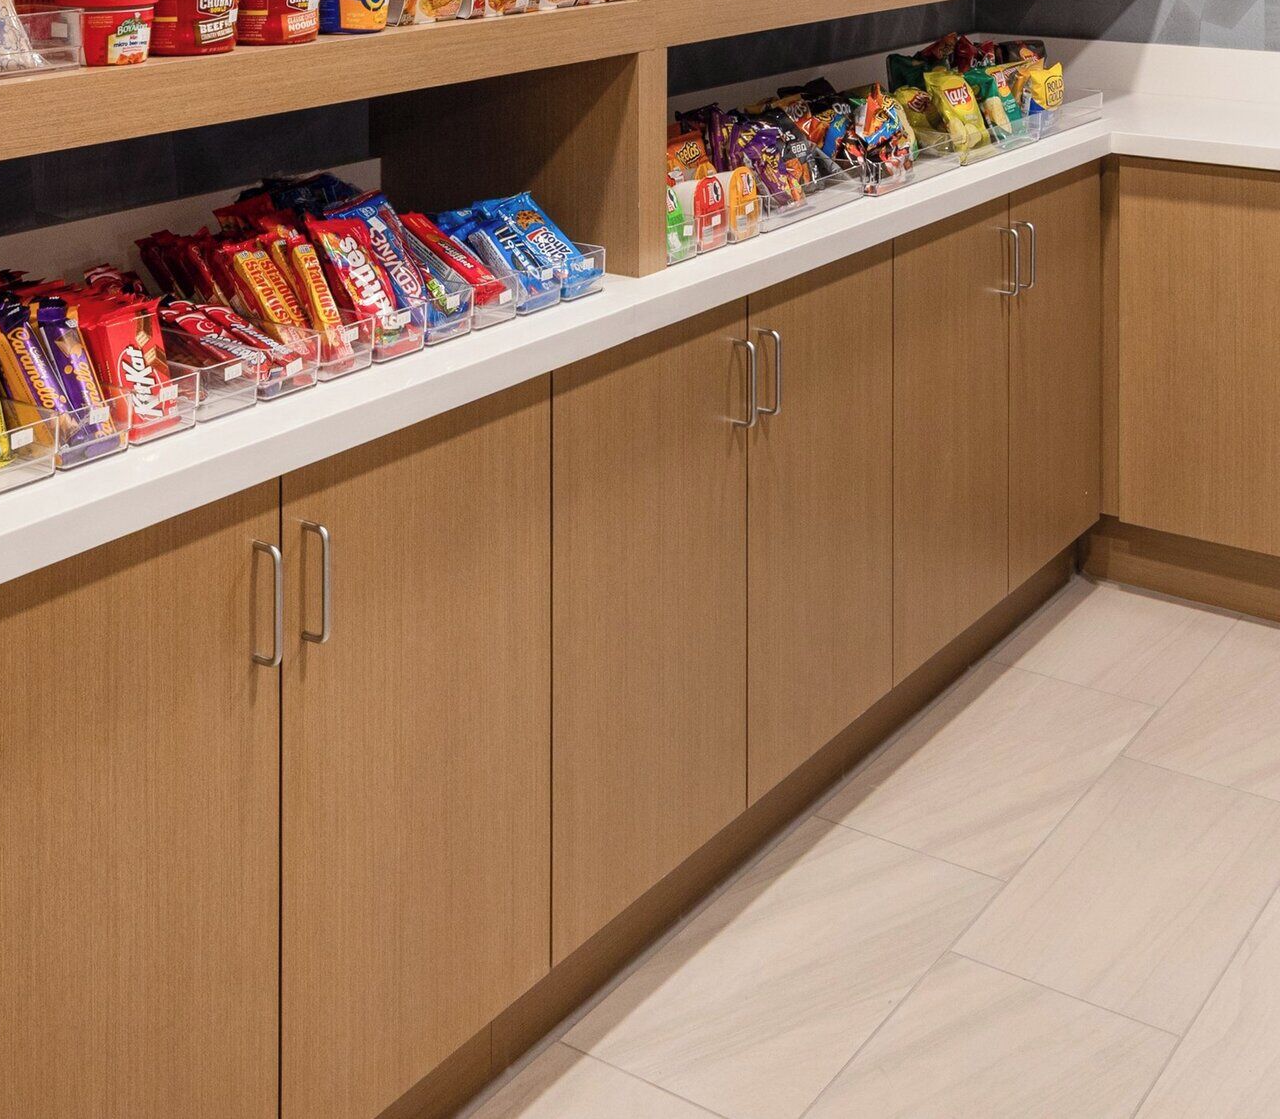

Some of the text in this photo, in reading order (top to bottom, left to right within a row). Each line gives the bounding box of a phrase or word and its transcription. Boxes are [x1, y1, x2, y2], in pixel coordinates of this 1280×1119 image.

[199, 19, 225, 34] BEEF
[288, 19, 317, 32] NOODLE
[1047, 79, 1064, 92] ROLD
[944, 85, 969, 106] Lay's
[791, 143, 807, 155] BBQ
[339, 236, 403, 330] Skittles
[7, 327, 60, 410] Caramello
